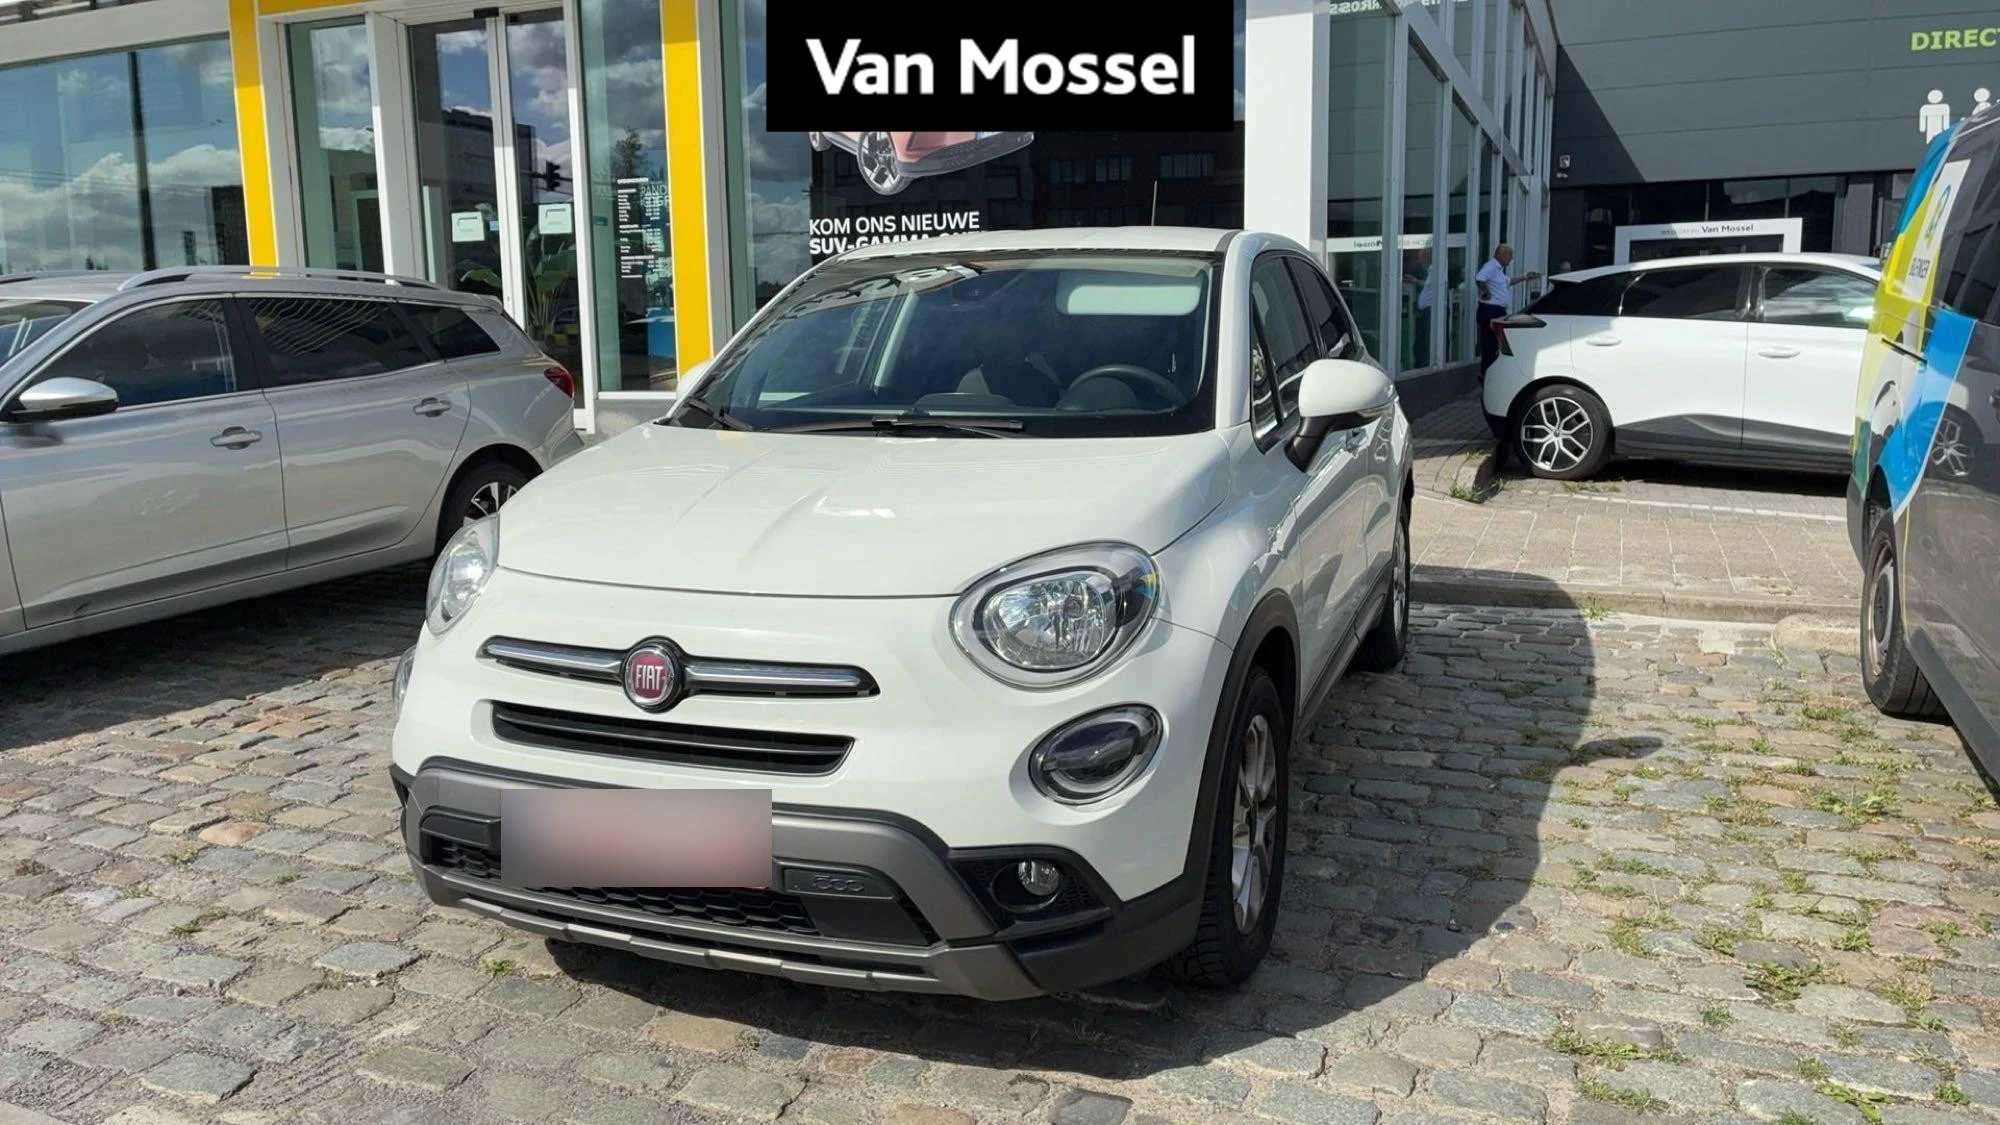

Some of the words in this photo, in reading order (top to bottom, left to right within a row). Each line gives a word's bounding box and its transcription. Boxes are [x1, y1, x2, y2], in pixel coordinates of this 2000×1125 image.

[809, 218, 850, 236] KOM
[856, 215, 896, 234] ONS
[901, 211, 980, 232] NIEUWE
[1702, 225, 1719, 234] Van
[1721, 224, 1754, 233] Mossel
[809, 233, 929, 255] SUV-GA
[636, 664, 664, 690] FIAT
